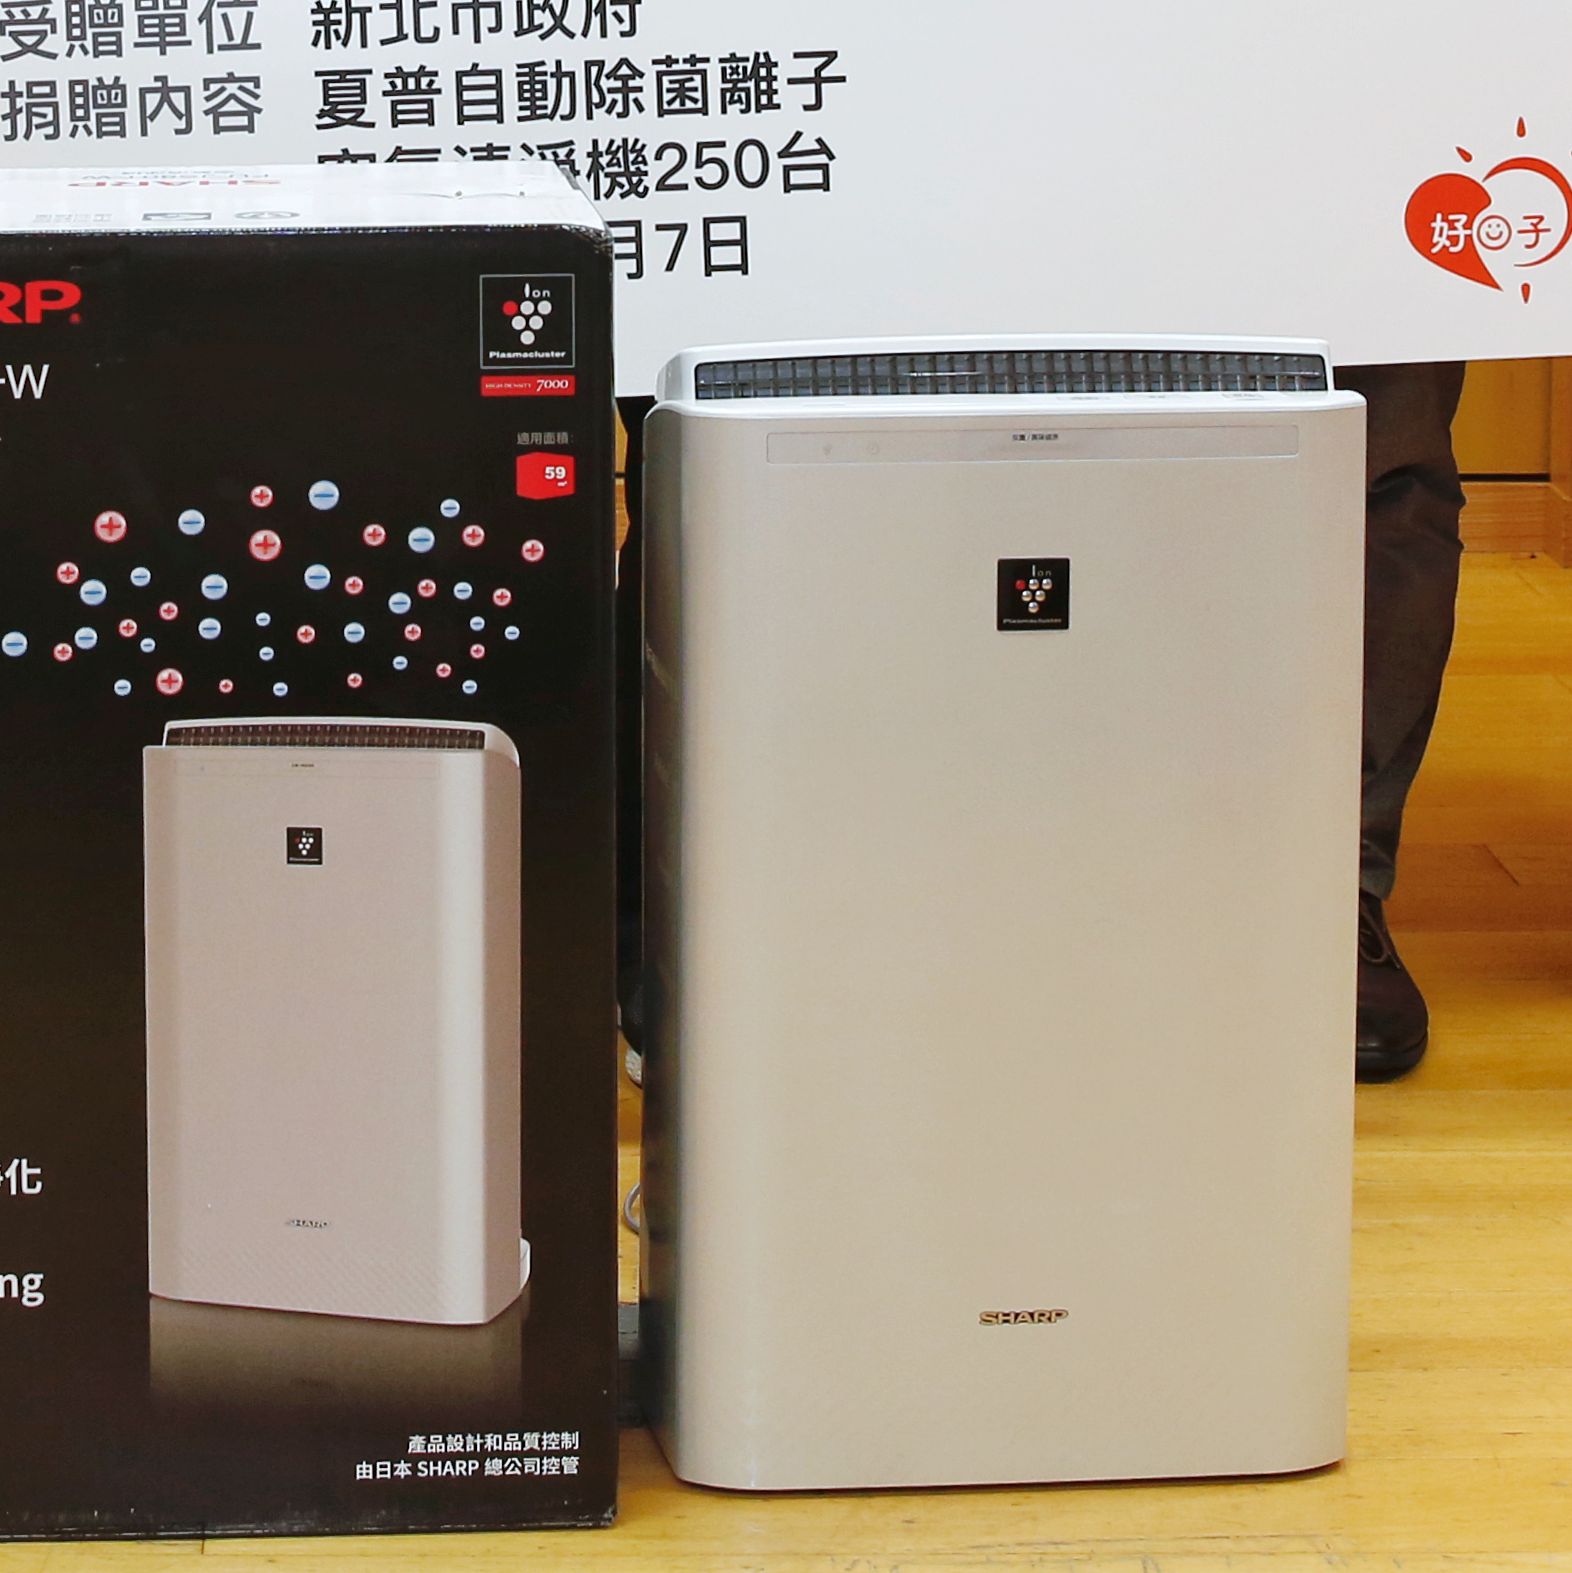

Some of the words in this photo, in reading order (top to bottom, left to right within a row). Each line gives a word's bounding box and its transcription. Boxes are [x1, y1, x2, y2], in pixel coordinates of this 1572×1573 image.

[0, 72, 264, 142] 捐贈內容
[314, 52, 848, 131] 夏普自動除菌離子
[489, 350, 566, 359] Plasmacluster
[536, 379, 569, 392] 7000
[545, 466, 566, 479] 59
[978, 1308, 1069, 1326] SHARP
[408, 1431, 580, 1454] 產品設計和品質控制
[355, 1459, 412, 1480] 由日本
[416, 1459, 479, 1477] SHARP
[483, 1456, 580, 1477] 總公司控管
